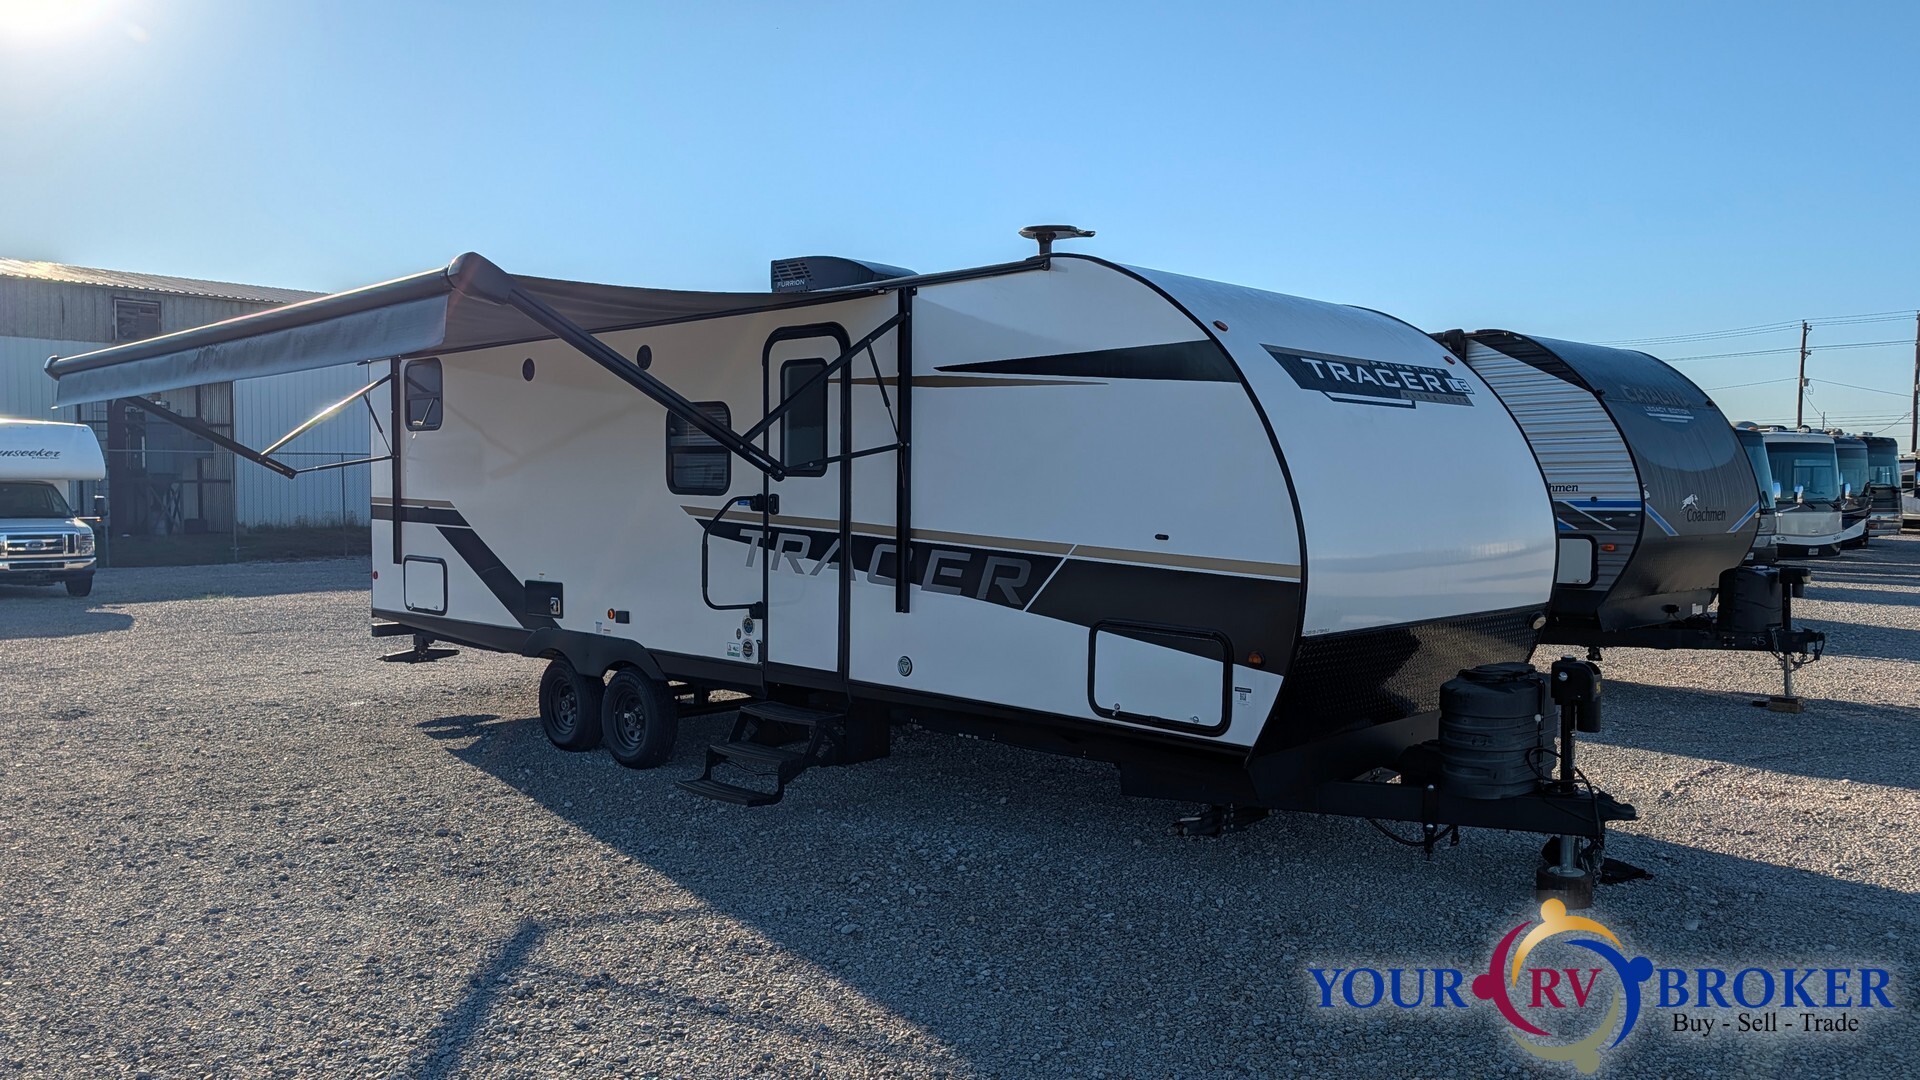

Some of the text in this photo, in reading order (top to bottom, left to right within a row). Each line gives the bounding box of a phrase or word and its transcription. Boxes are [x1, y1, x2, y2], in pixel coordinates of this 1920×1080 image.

[777, 279, 805, 288] FURRION
[1301, 358, 1447, 393] TRACER
[1686, 507, 1726, 522] Coachmen
[739, 528, 1031, 606] TRACER
